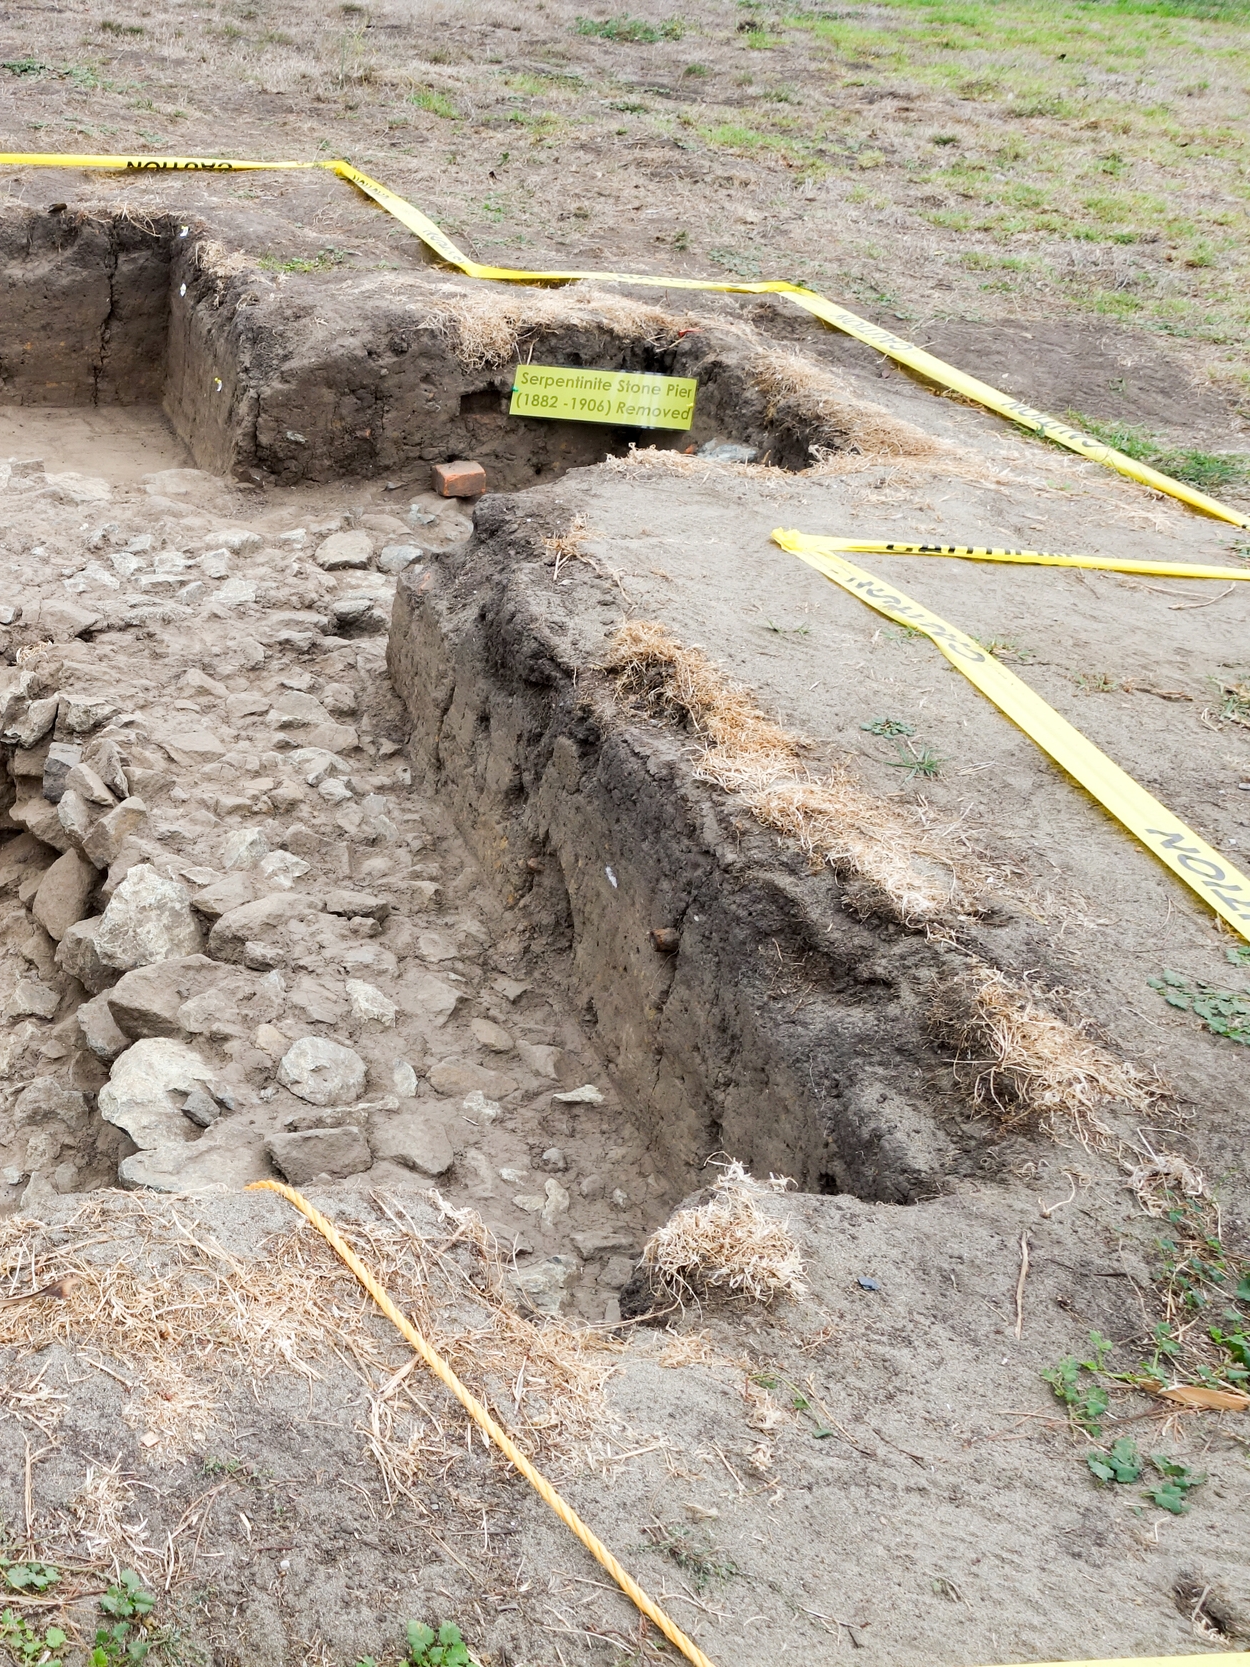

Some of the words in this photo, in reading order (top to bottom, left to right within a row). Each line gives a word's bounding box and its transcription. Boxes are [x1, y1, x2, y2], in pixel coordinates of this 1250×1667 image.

[521, 372, 612, 391] Serpentinite
[617, 380, 661, 395] Stone
[666, 384, 692, 398] Pier
[516, 392, 558, 409] (1882
[563, 397, 612, 416] -1906)
[616, 401, 691, 420] Removed
